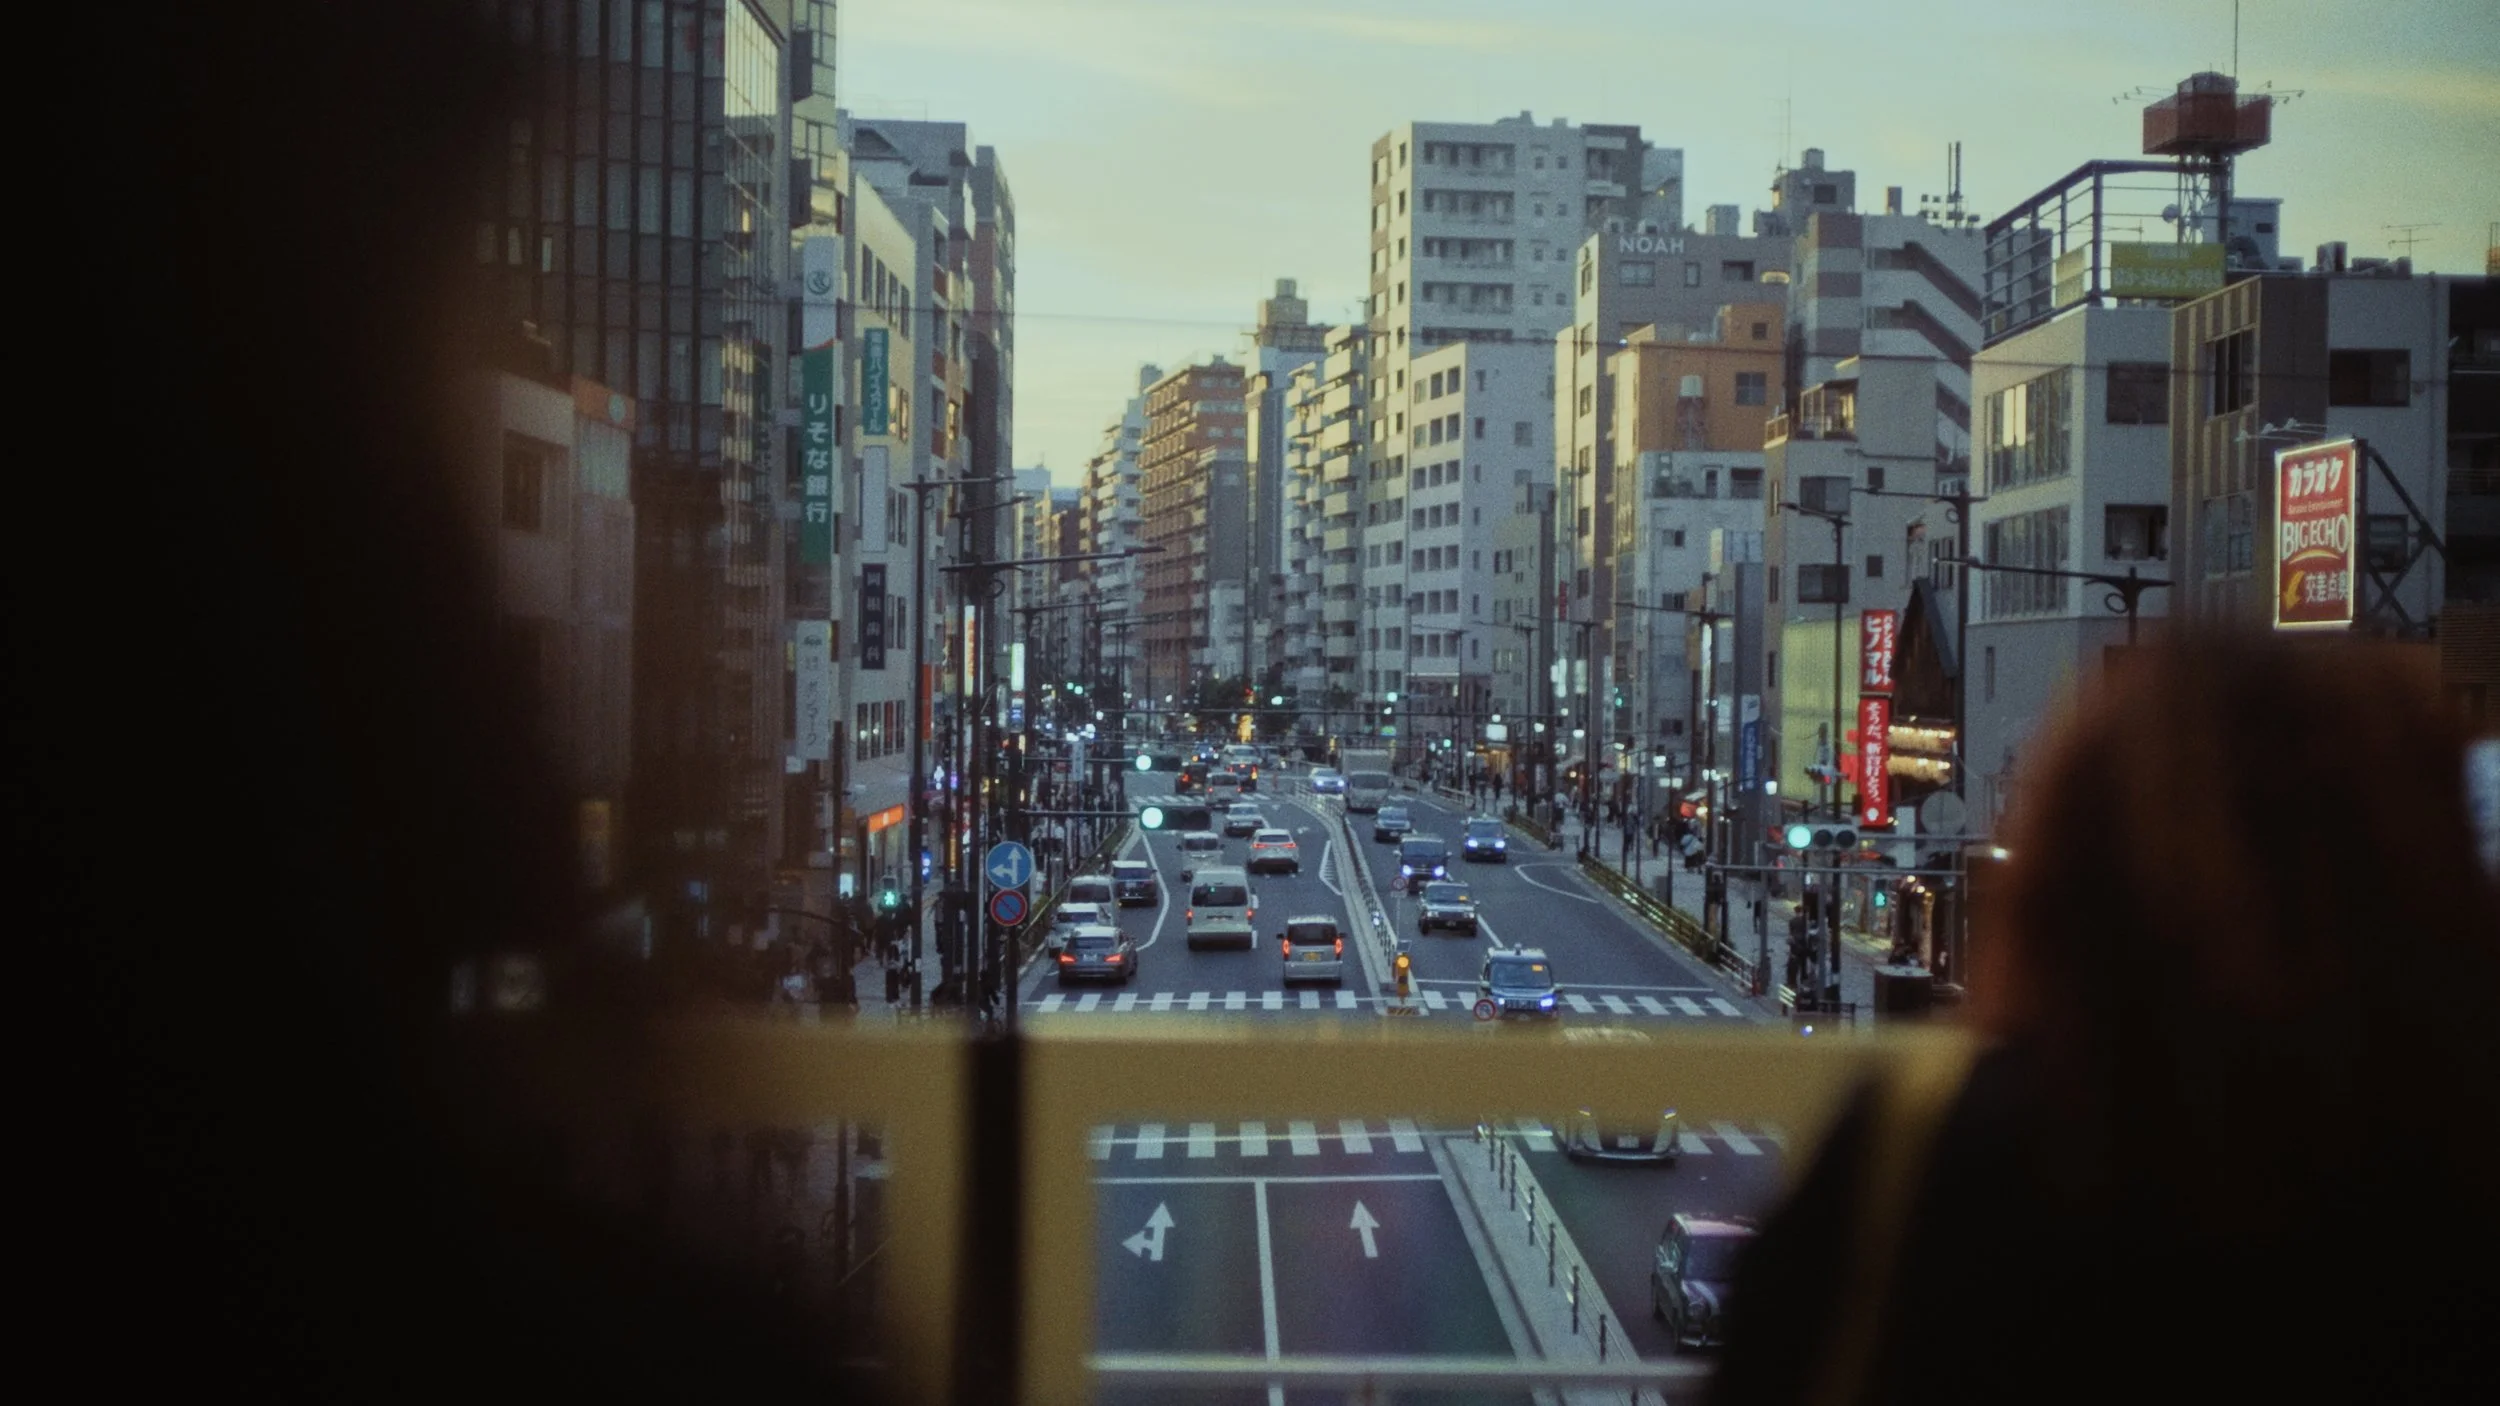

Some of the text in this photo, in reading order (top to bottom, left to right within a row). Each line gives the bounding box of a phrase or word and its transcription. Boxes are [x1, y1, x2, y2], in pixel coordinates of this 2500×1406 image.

[1619, 236, 1685, 254] NOAH
[806, 393, 829, 523] りそな銀行
[2289, 456, 2344, 498] カラオケ
[1866, 616, 1883, 685] ヒノマル
